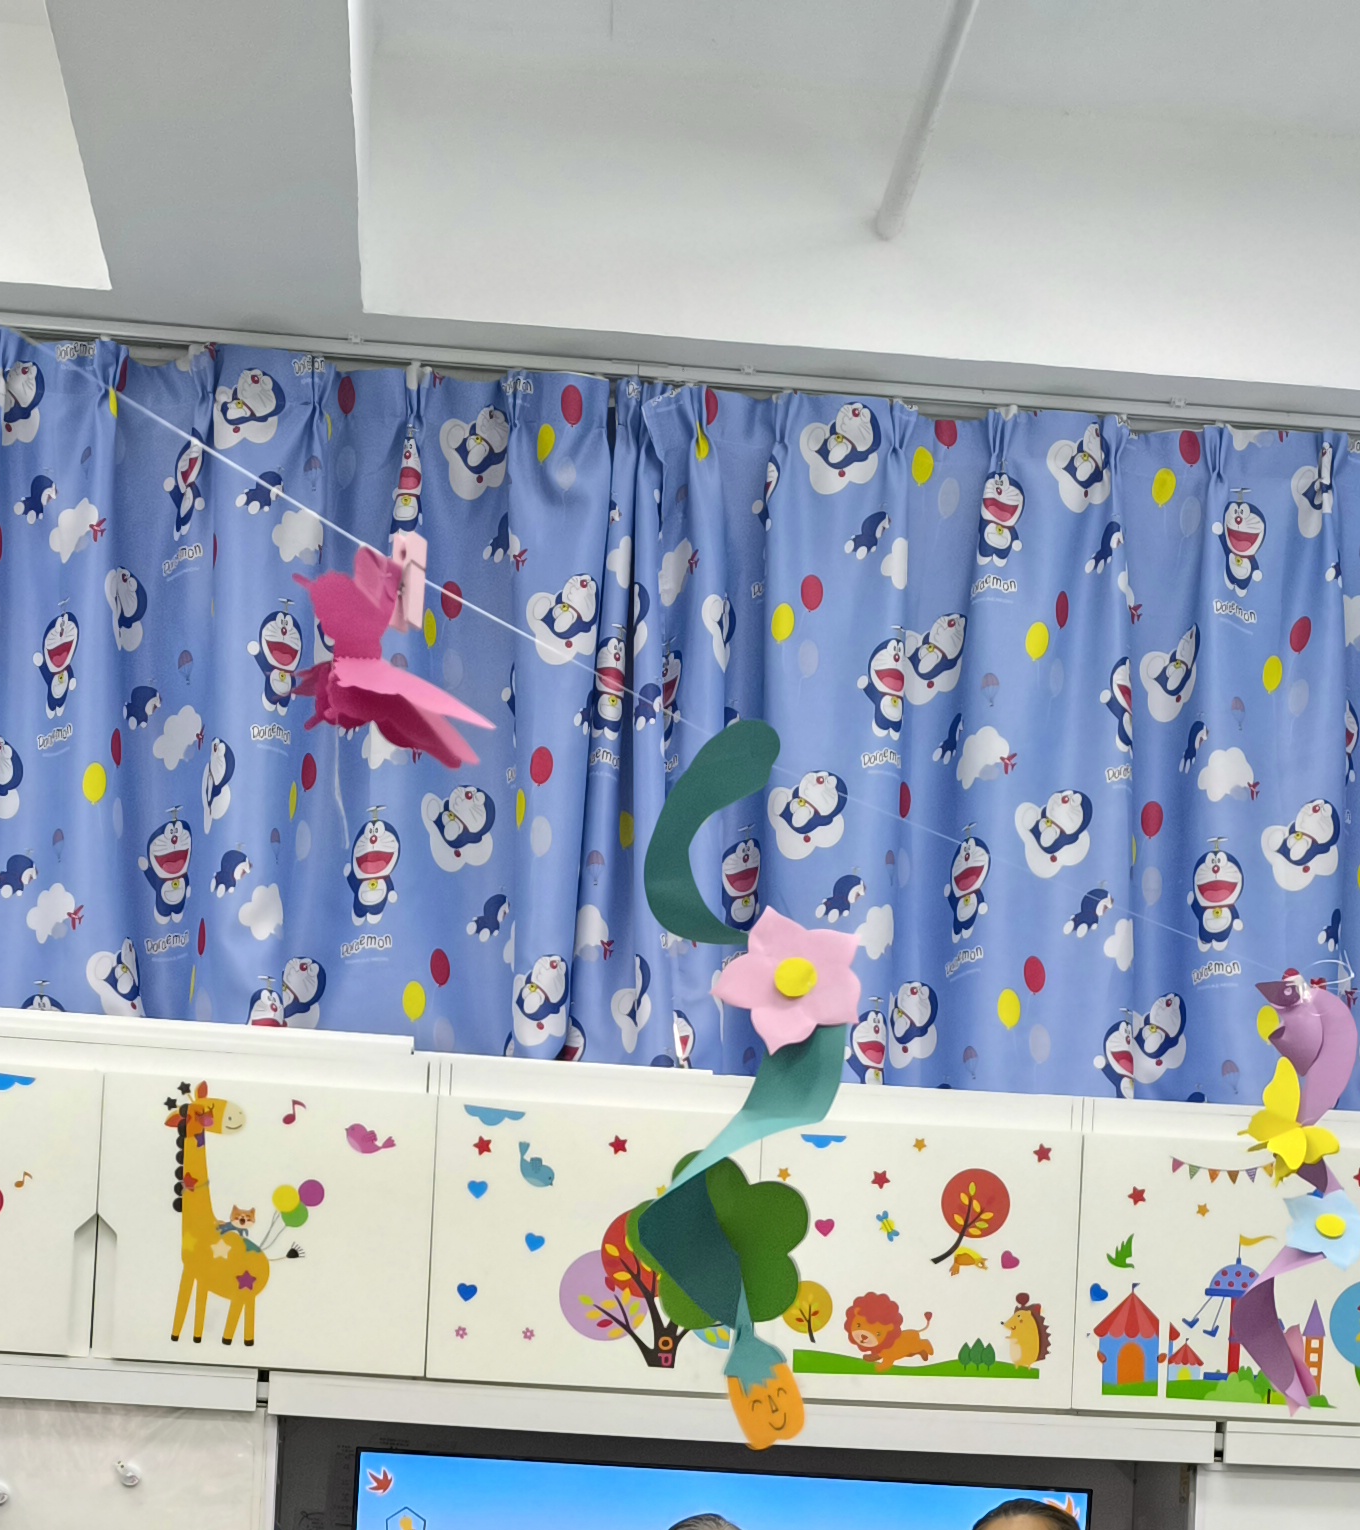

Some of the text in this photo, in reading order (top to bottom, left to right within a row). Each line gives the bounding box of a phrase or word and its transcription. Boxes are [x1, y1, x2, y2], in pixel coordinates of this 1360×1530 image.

[145, 931, 189, 954] Doraemon
[341, 934, 392, 958] Doraemon
[1192, 960, 1241, 984] Doraemon
